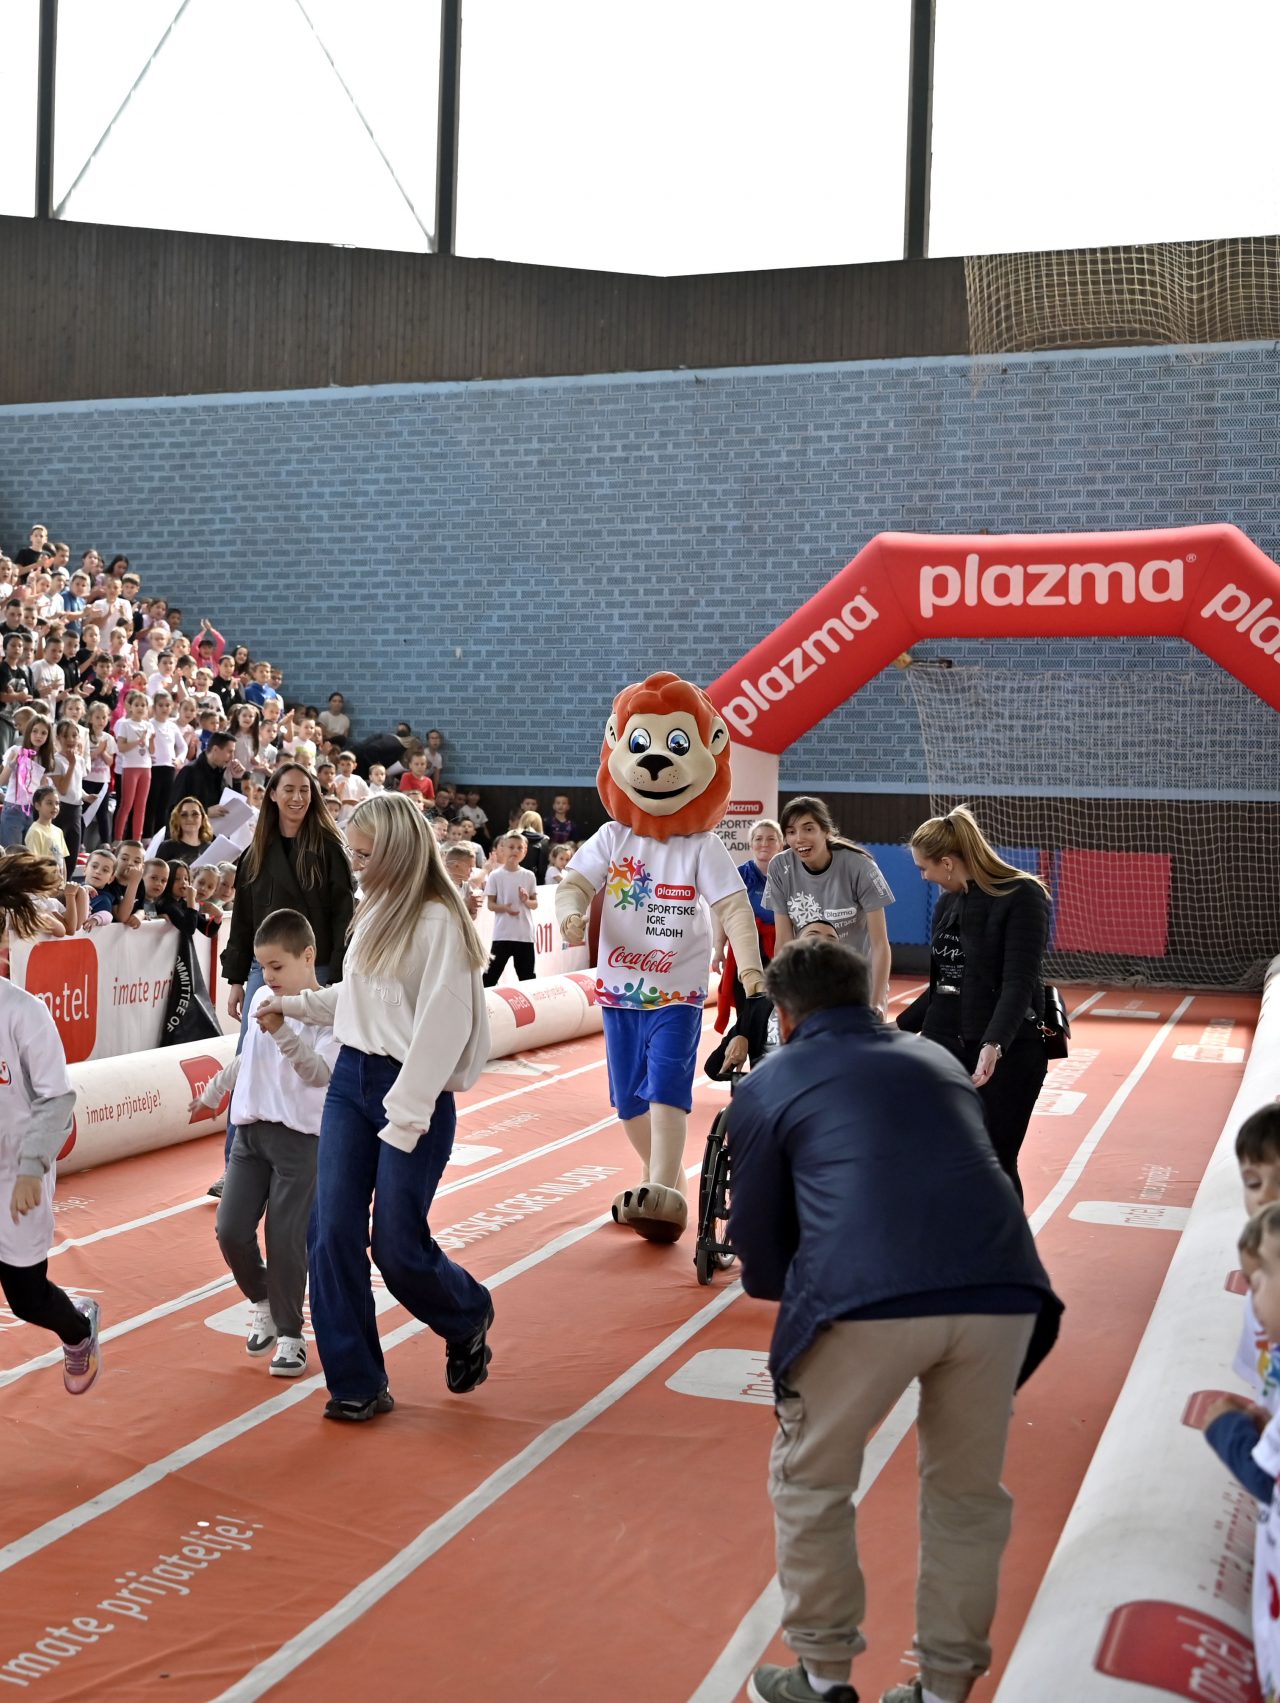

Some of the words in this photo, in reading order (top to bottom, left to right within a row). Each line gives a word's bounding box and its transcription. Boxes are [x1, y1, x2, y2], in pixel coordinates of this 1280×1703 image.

[920, 553, 1184, 618] plazma
[1200, 584, 1280, 664] pla
[721, 593, 879, 738] plazma
[715, 819, 756, 829] SPORTS
[727, 842, 752, 850] LADI
[657, 886, 691, 897] plazma
[647, 904, 696, 916] SPORTSKE
[646, 915, 666, 926] IGRE
[834, 917, 857, 929] RTSKE
[645, 926, 683, 938] MLADIH
[113, 977, 149, 1006] imate
[86, 1104, 114, 1125] imate
[116, 1089, 161, 1122] prijatelje!
[97, 1515, 264, 1622] prijatelje!
